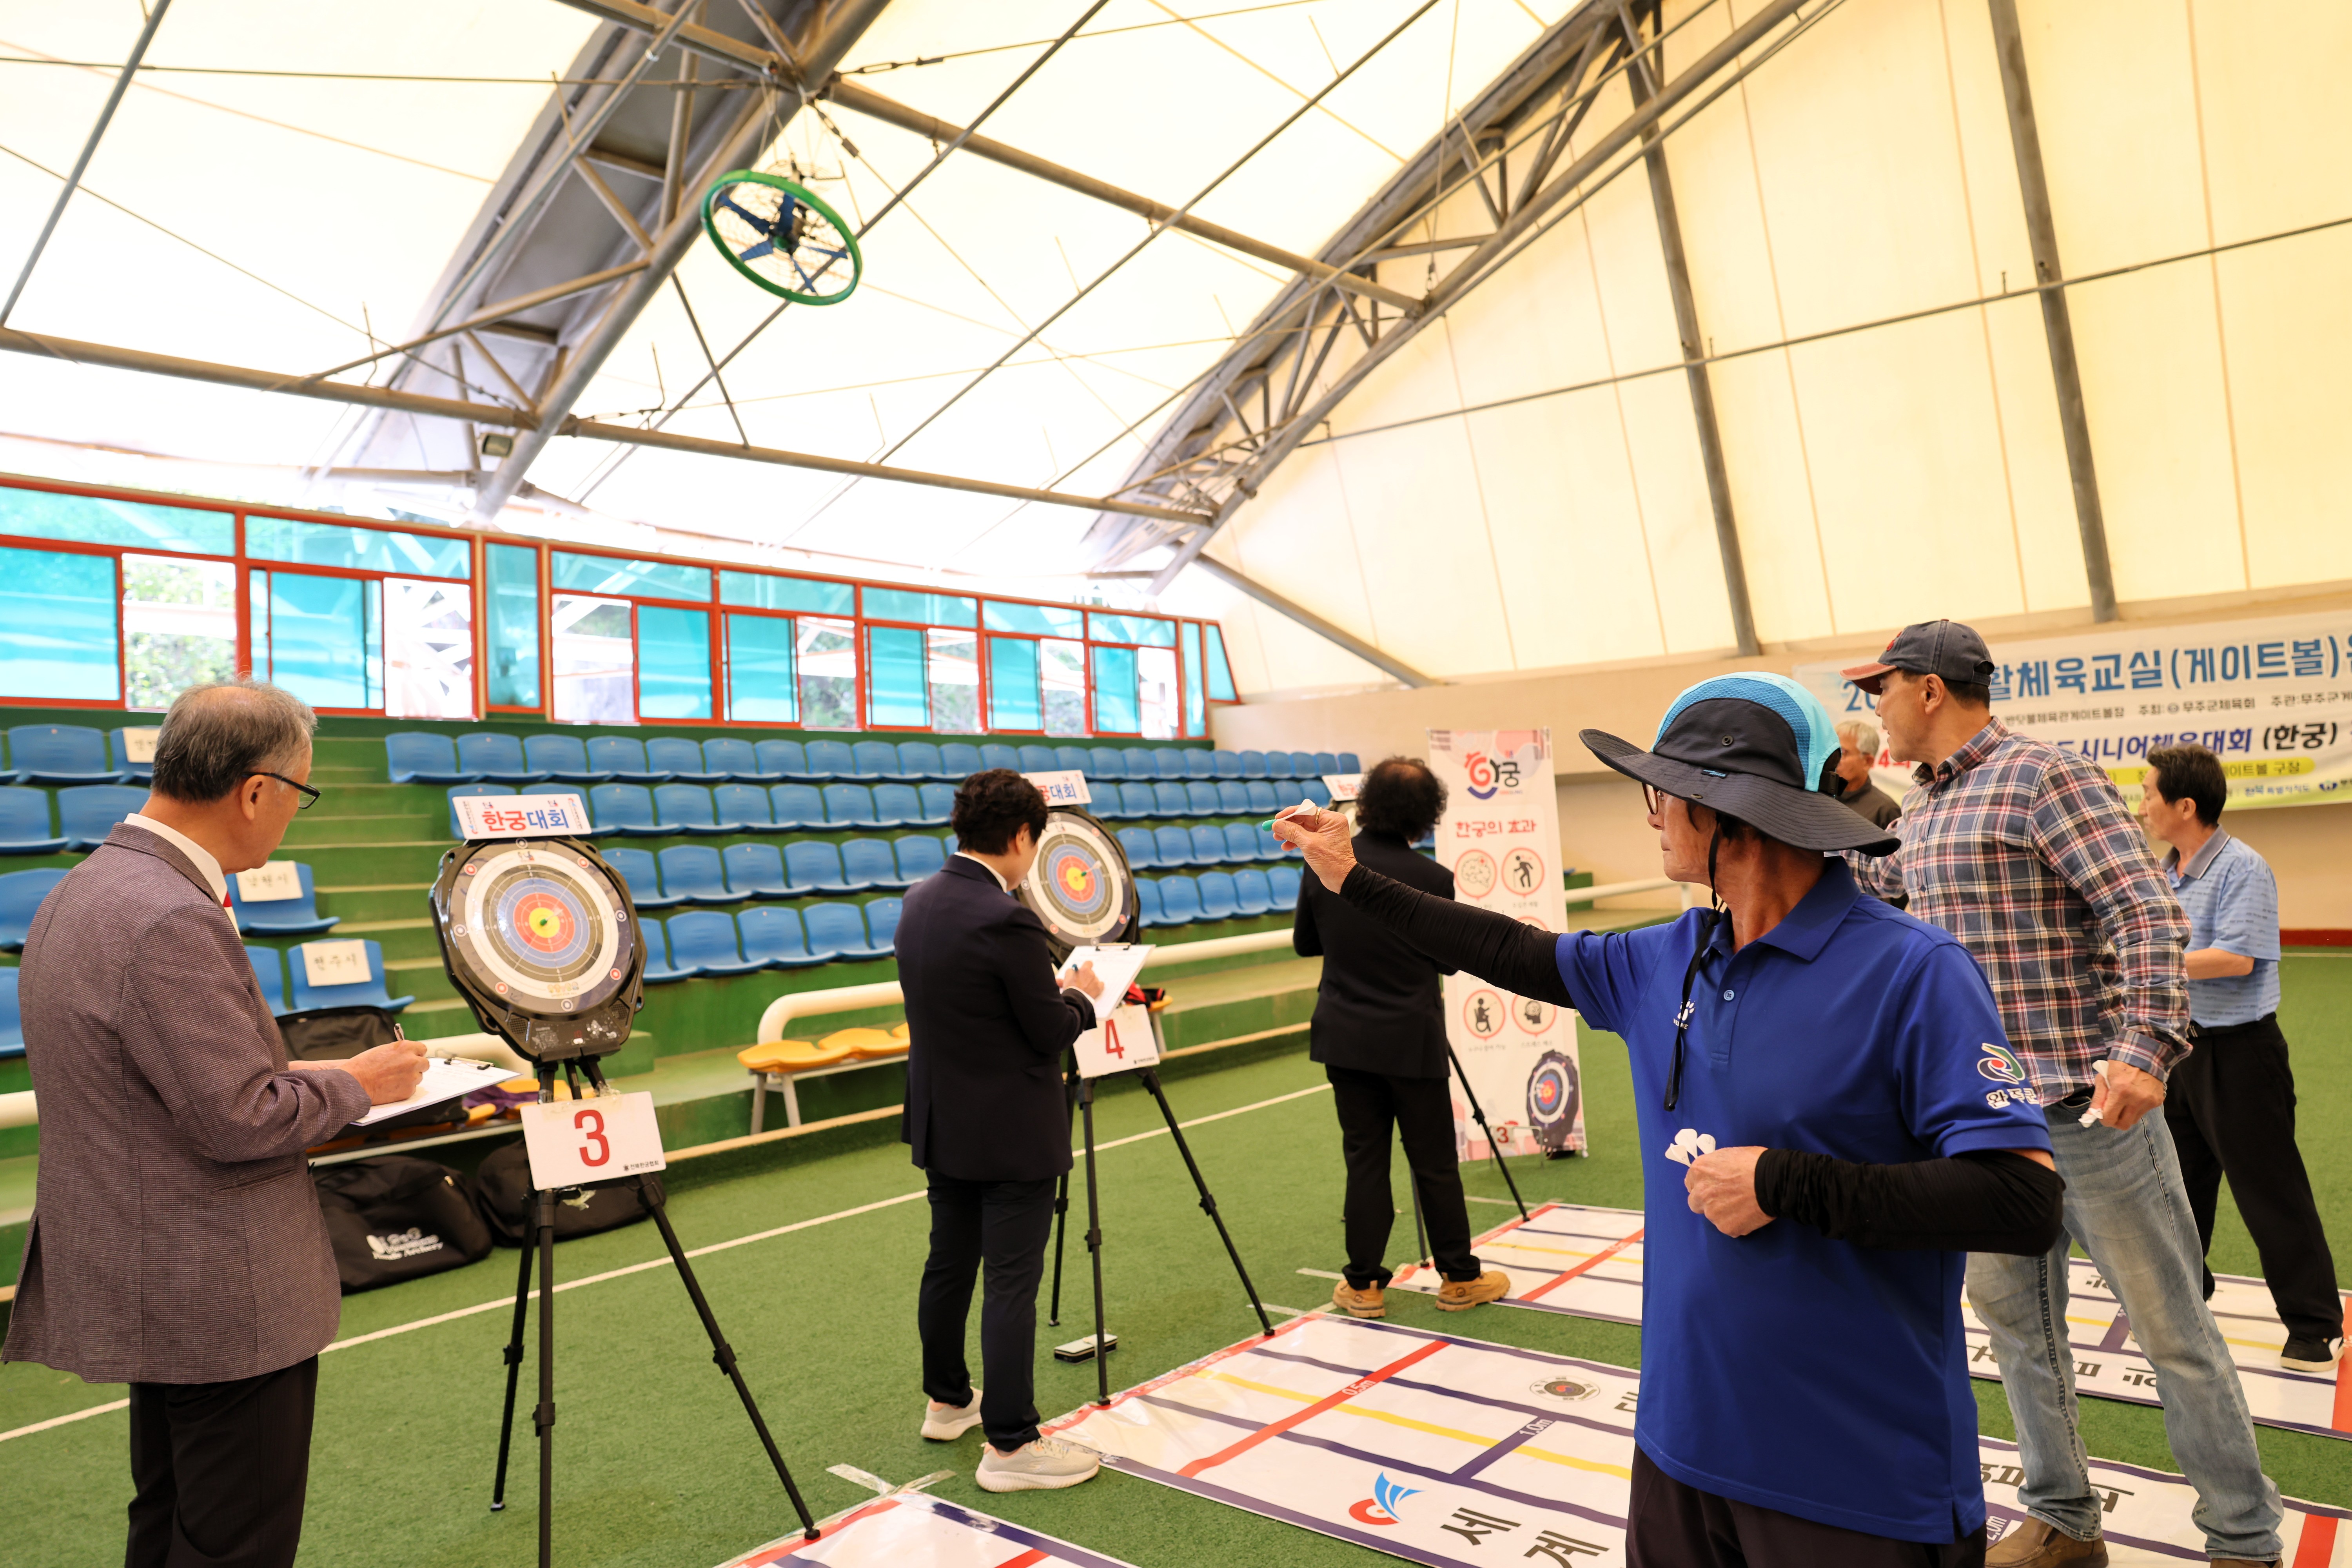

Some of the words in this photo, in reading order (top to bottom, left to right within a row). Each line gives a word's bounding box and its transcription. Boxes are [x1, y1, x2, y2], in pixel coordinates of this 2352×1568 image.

[1990, 635, 2352, 701] 활체육교실(게이트볼)
[2183, 697, 2256, 713] 무주군체육회
[2263, 722, 2337, 750] (한궁)
[482, 809, 569, 831] 한궁대회
[1455, 820, 1502, 838] 한궁의
[1508, 819, 1537, 833] 효과
[1105, 1019, 1125, 1059] 4
[1986, 1087, 2040, 1109] 완주군
[574, 1109, 610, 1167] 3
[1496, 1127, 1509, 1143] 3
[1341, 1379, 1377, 1396] 0.5m
[1519, 1419, 1553, 1436] 1.0m
